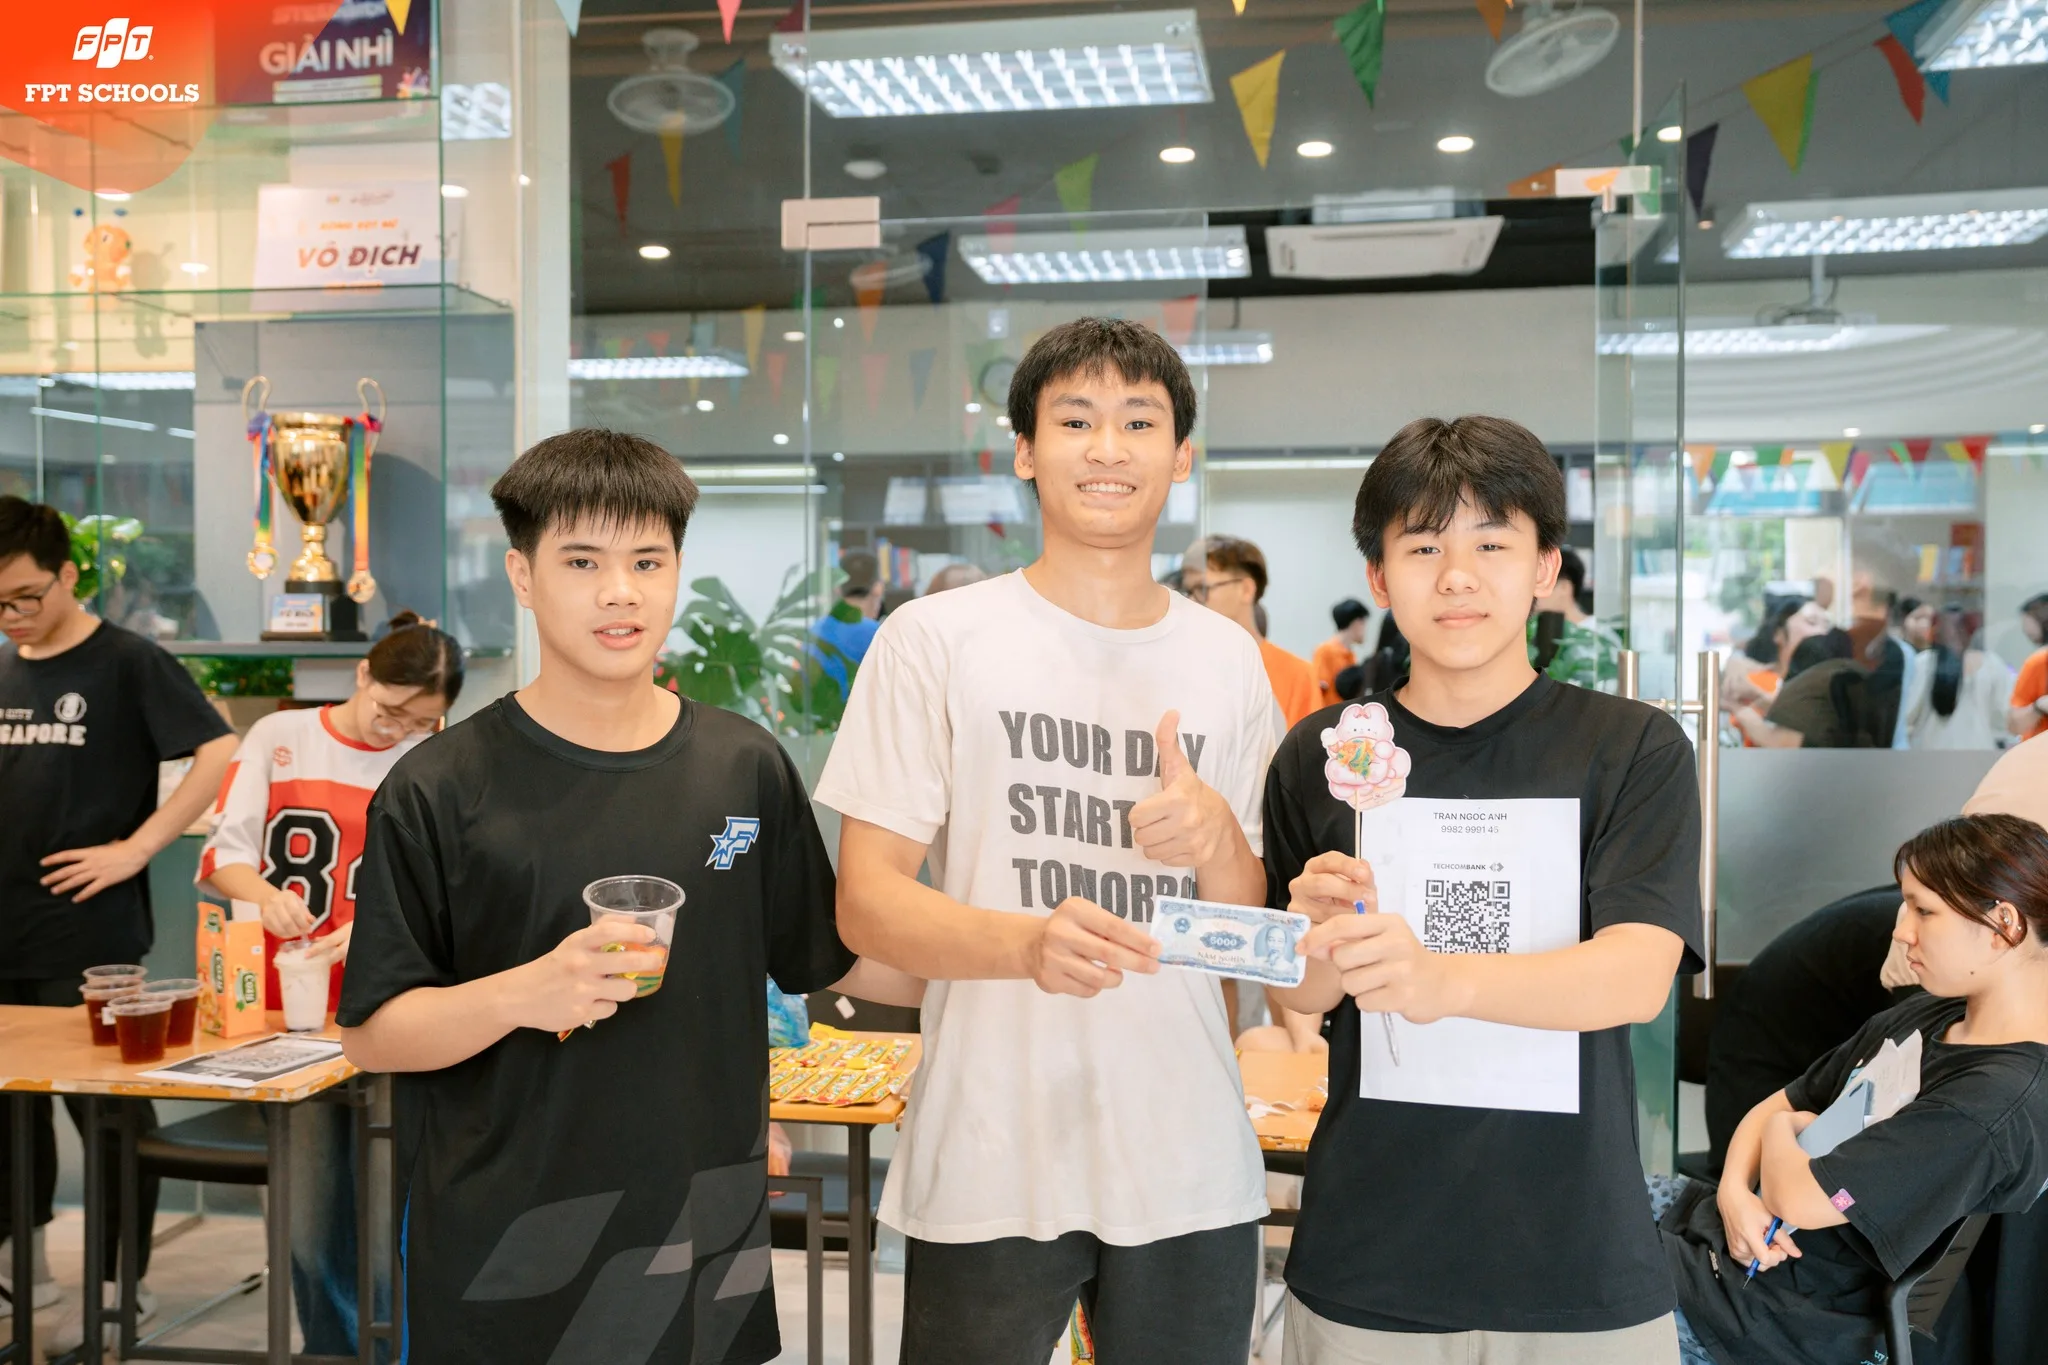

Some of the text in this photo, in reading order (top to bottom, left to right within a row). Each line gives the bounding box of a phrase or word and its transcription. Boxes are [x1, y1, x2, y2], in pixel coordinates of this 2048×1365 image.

[335, 28, 394, 69] NHÌ
[348, 244, 422, 273] ĐỊCH
[998, 711, 1206, 777] YOUR DY
[1433, 812, 1507, 821] TRAN NGOC ANH
[1441, 825, 1463, 833] 9982
[1210, 936, 1238, 946] 5000
